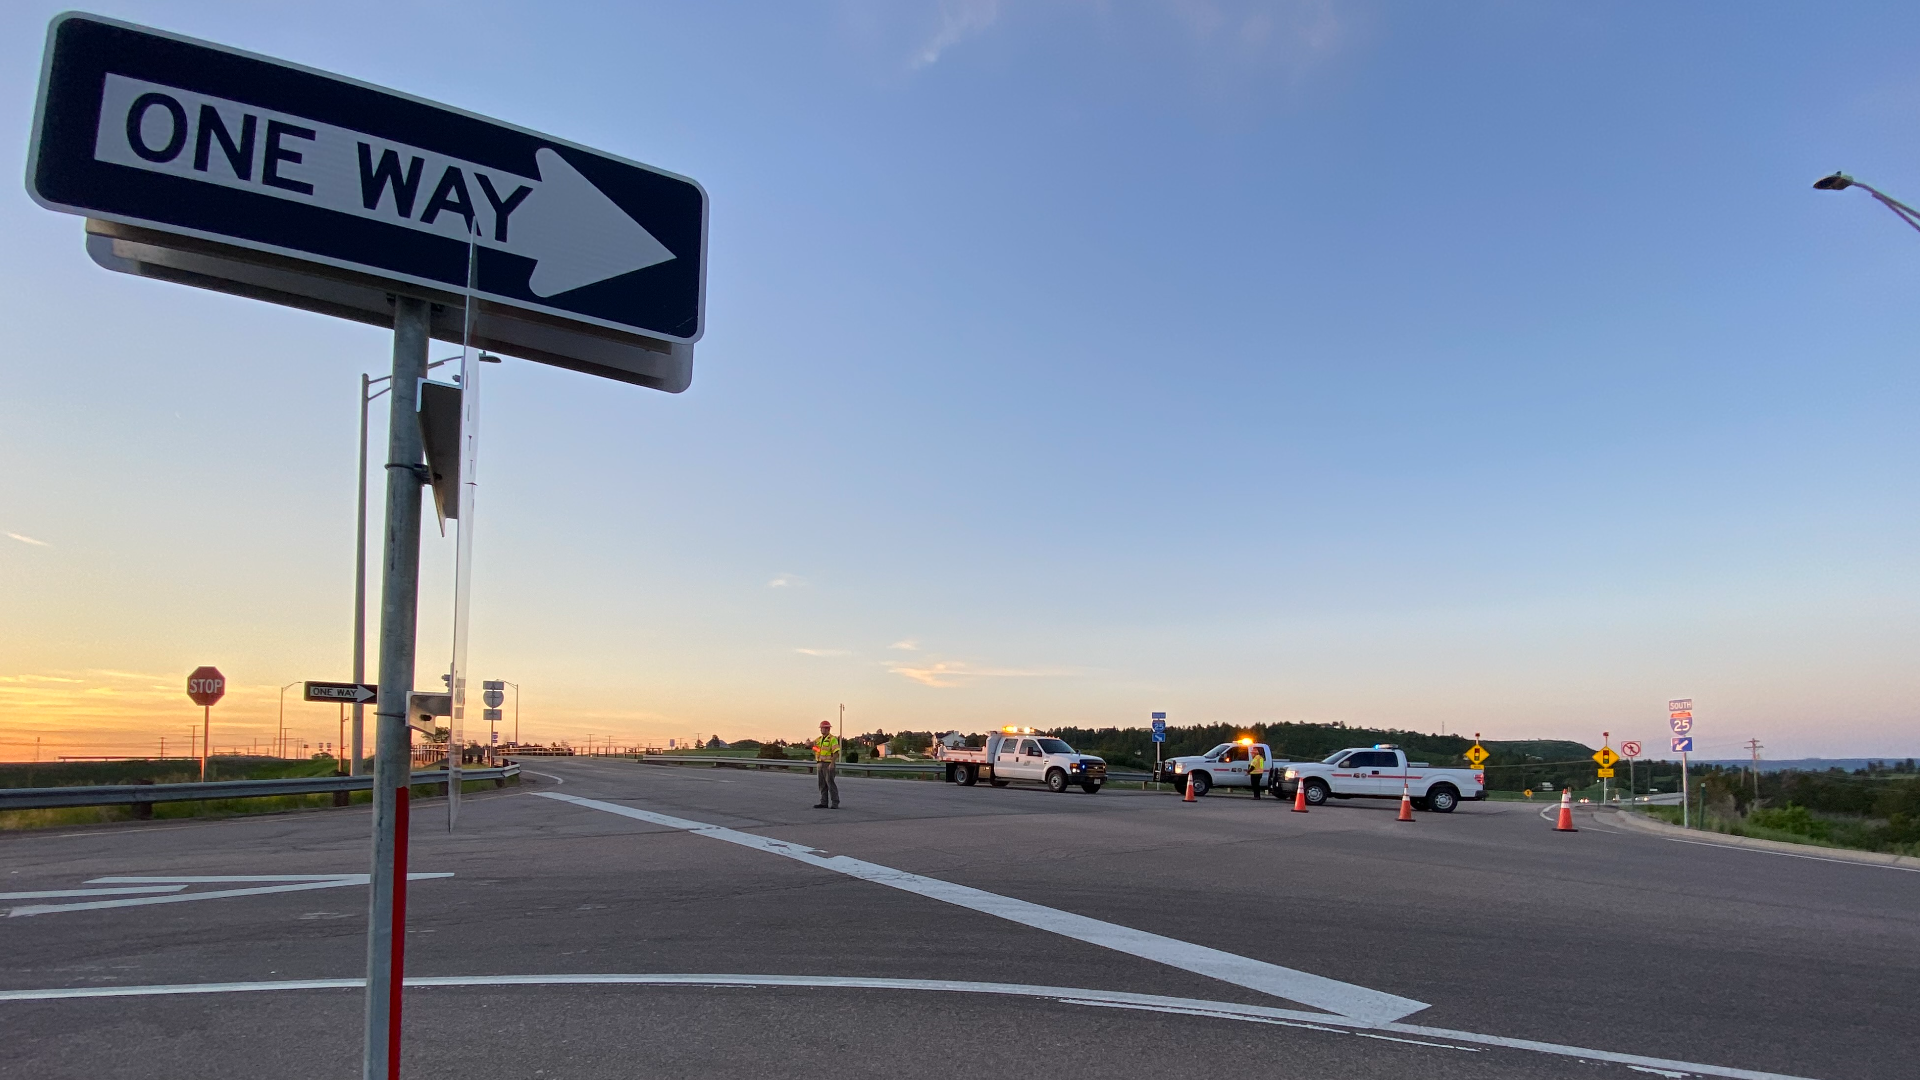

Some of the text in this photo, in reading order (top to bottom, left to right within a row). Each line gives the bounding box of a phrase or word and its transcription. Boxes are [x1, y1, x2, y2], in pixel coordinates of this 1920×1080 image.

[126, 92, 533, 242] ONE WAY
[190, 678, 222, 694] STOP
[313, 687, 357, 698] ONE WAY
[1670, 702, 1691, 710] SOUTH
[1154, 723, 1164, 731] 25
[1674, 719, 1690, 732] 25
